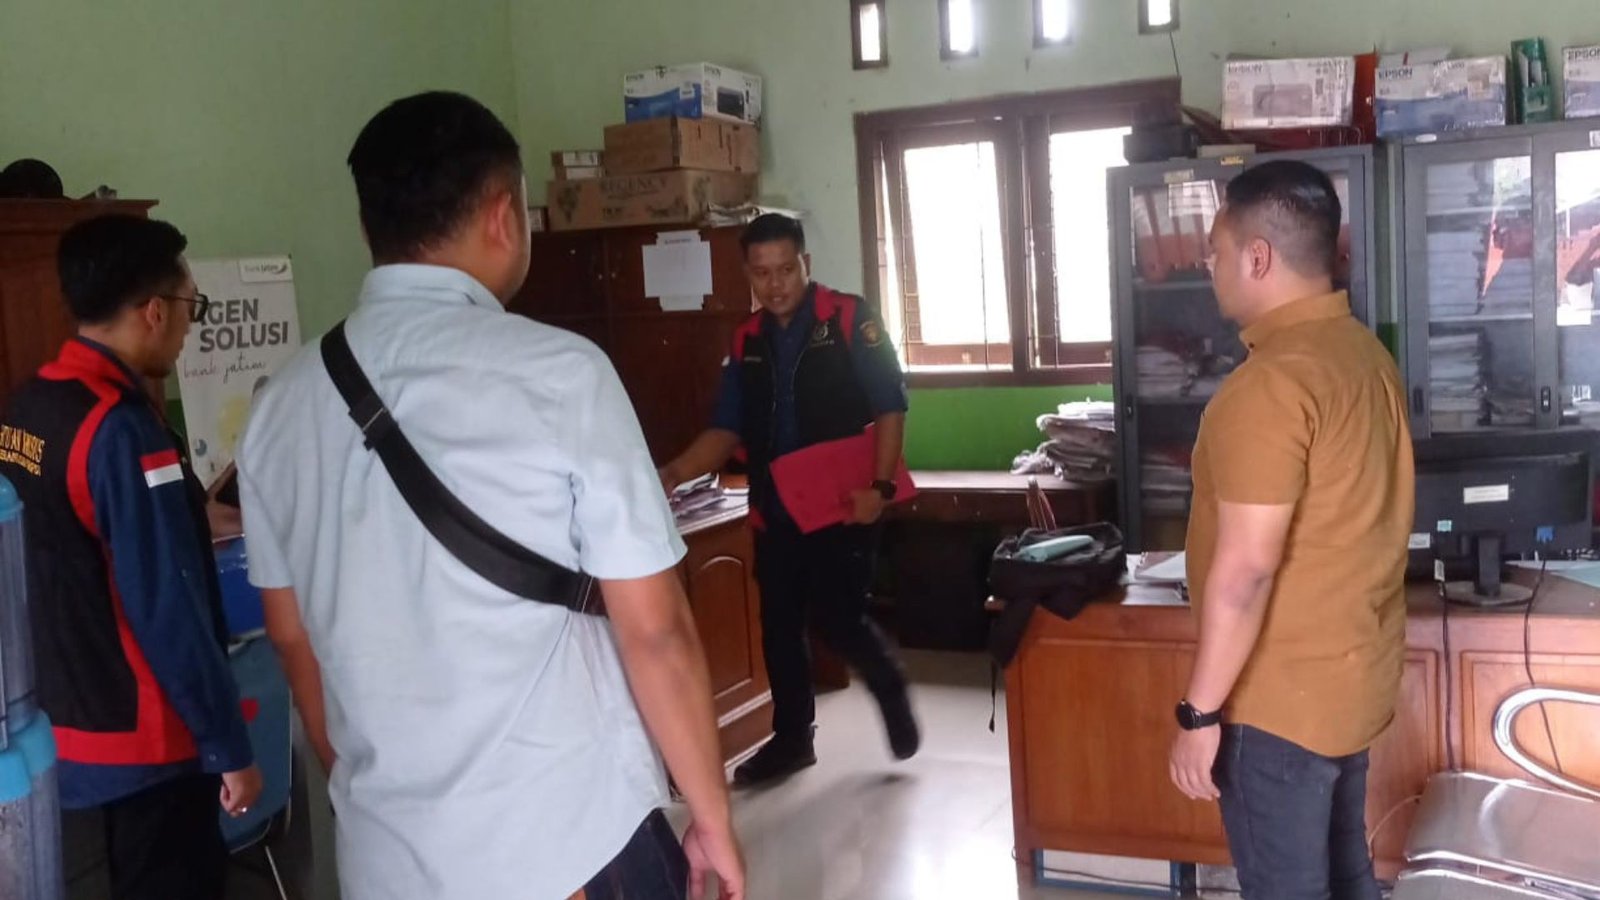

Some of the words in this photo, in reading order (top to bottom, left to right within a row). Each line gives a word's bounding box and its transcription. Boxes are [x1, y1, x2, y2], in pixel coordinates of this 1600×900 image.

[1378, 67, 1413, 79] EPSON
[201, 298, 259, 326] GEN
[199, 321, 289, 353] SOLUSI
[184, 355, 217, 378] bank
